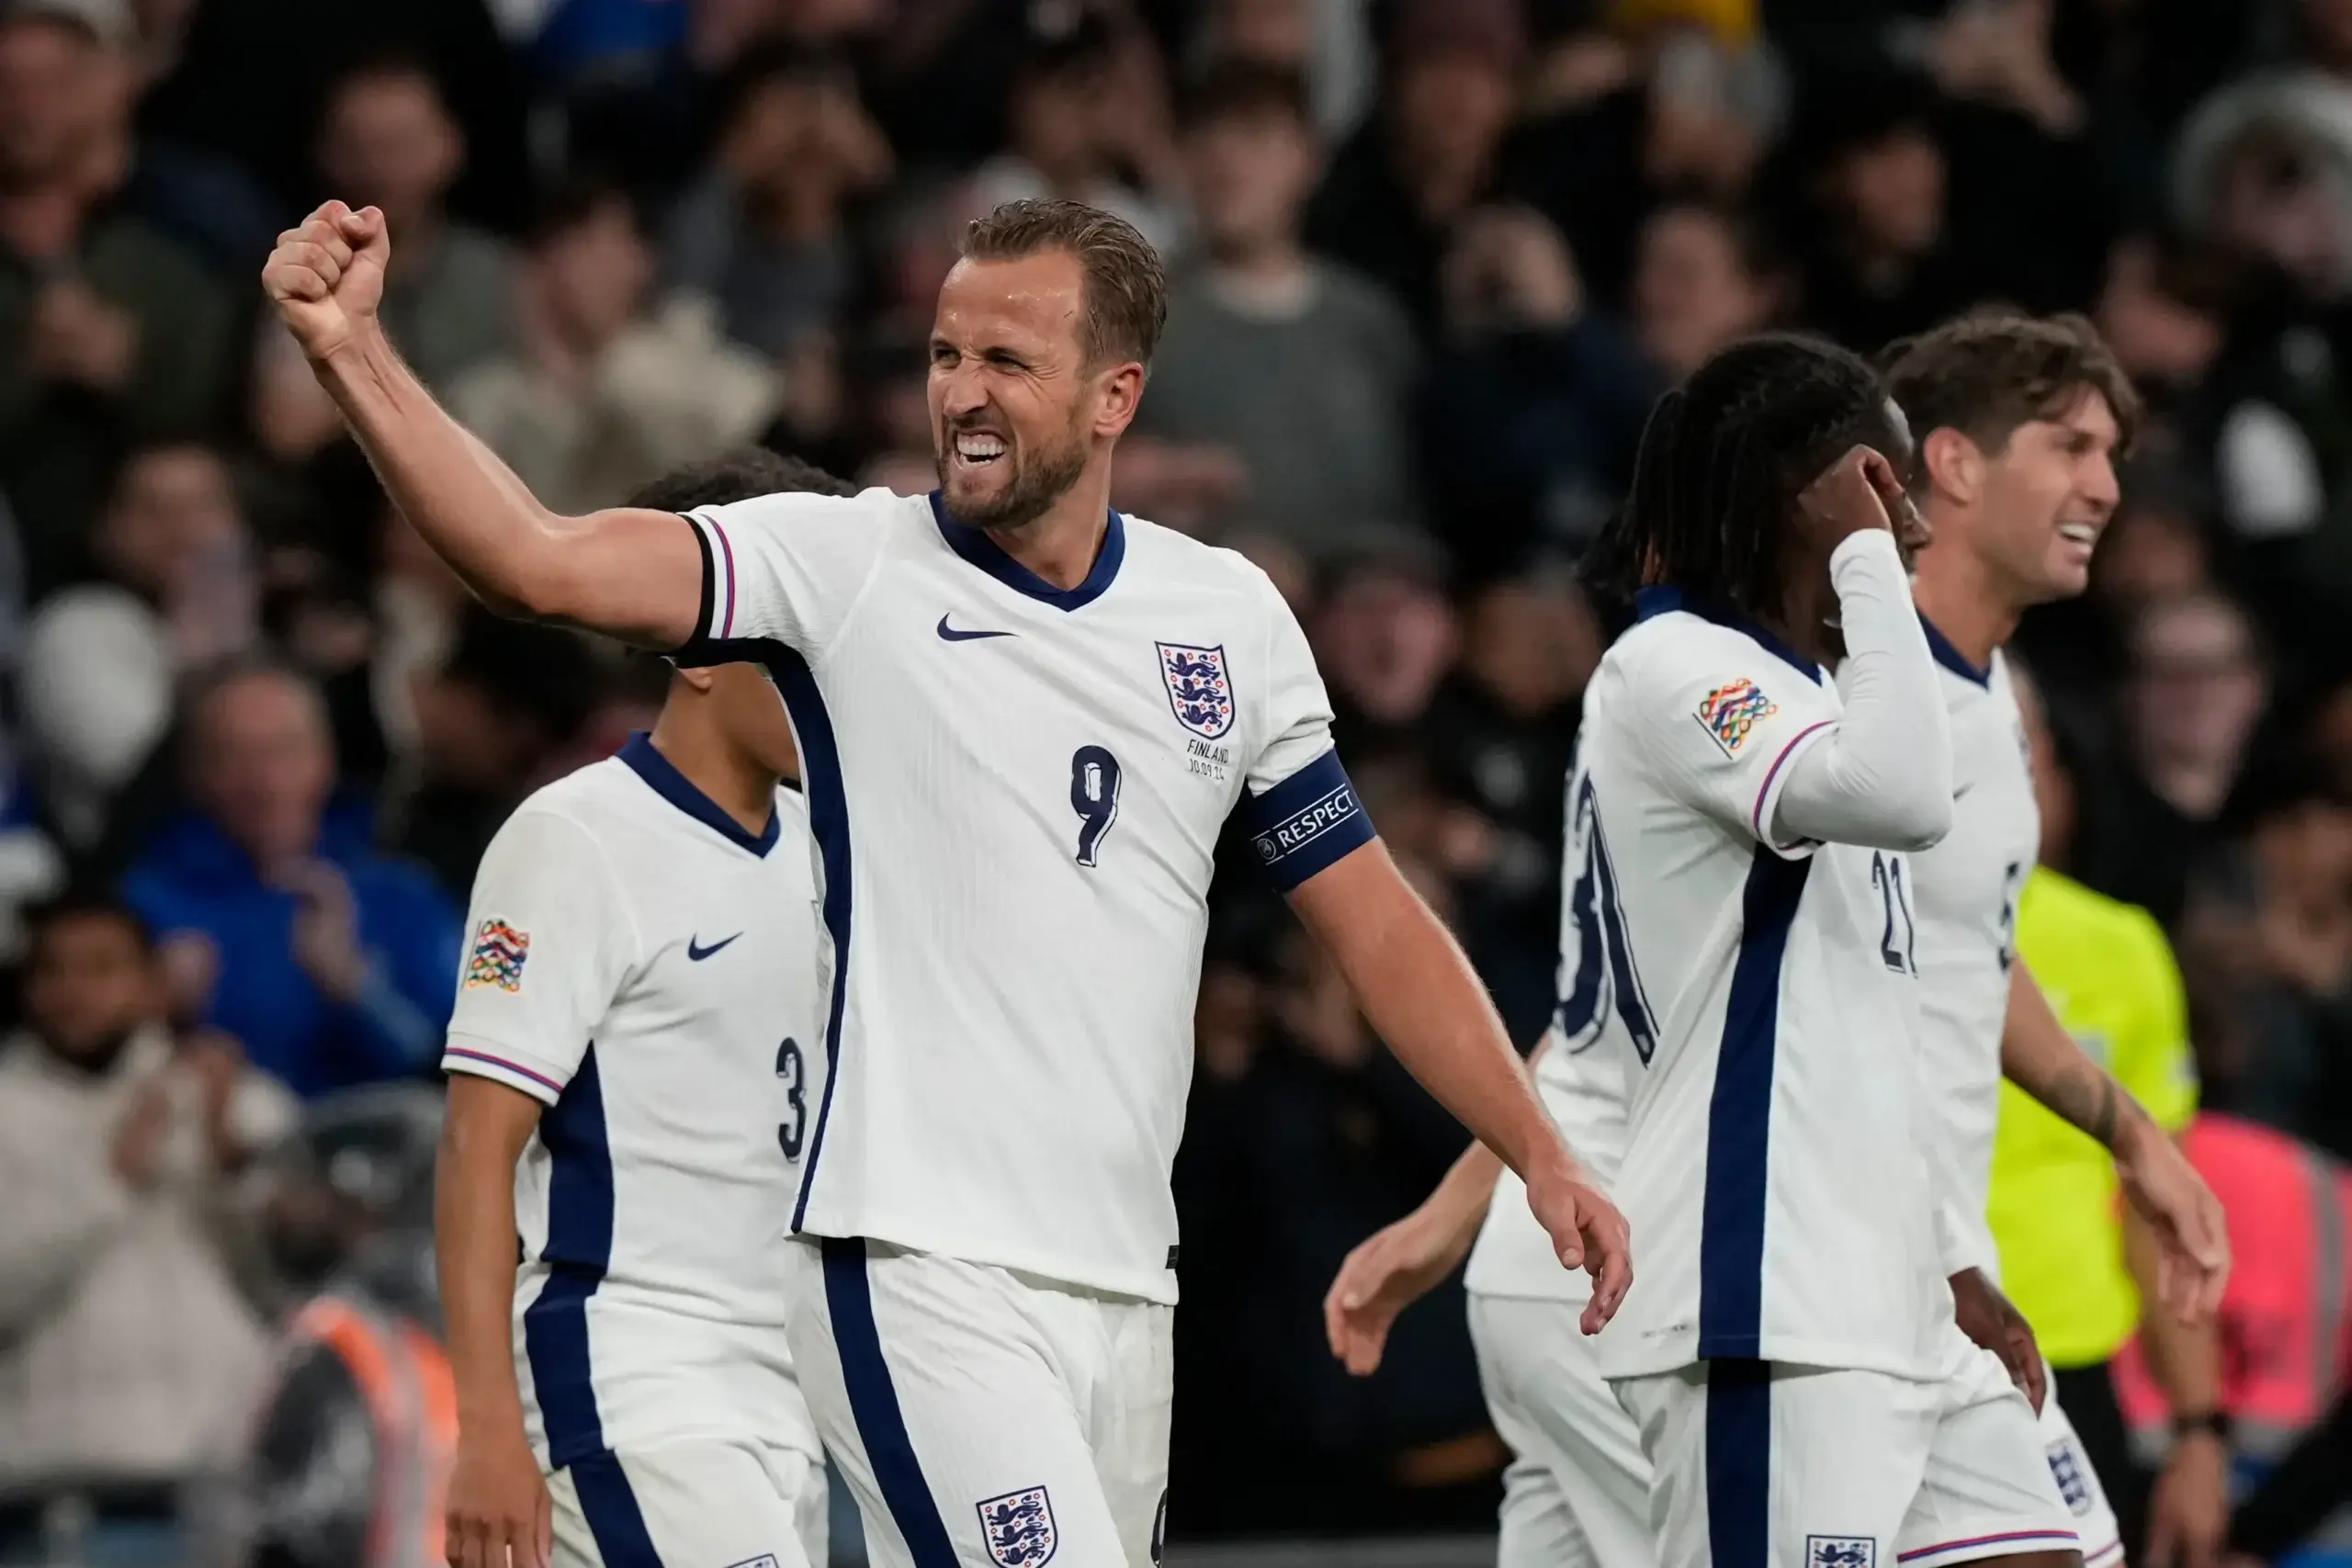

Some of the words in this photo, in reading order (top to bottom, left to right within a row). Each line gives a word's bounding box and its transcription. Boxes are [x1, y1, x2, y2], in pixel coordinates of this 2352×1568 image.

[1187, 739, 1229, 763] FINLAND
[1070, 744, 1122, 868] 9
[1277, 789, 1353, 848] RESPECT
[775, 1037, 806, 1164] 3
